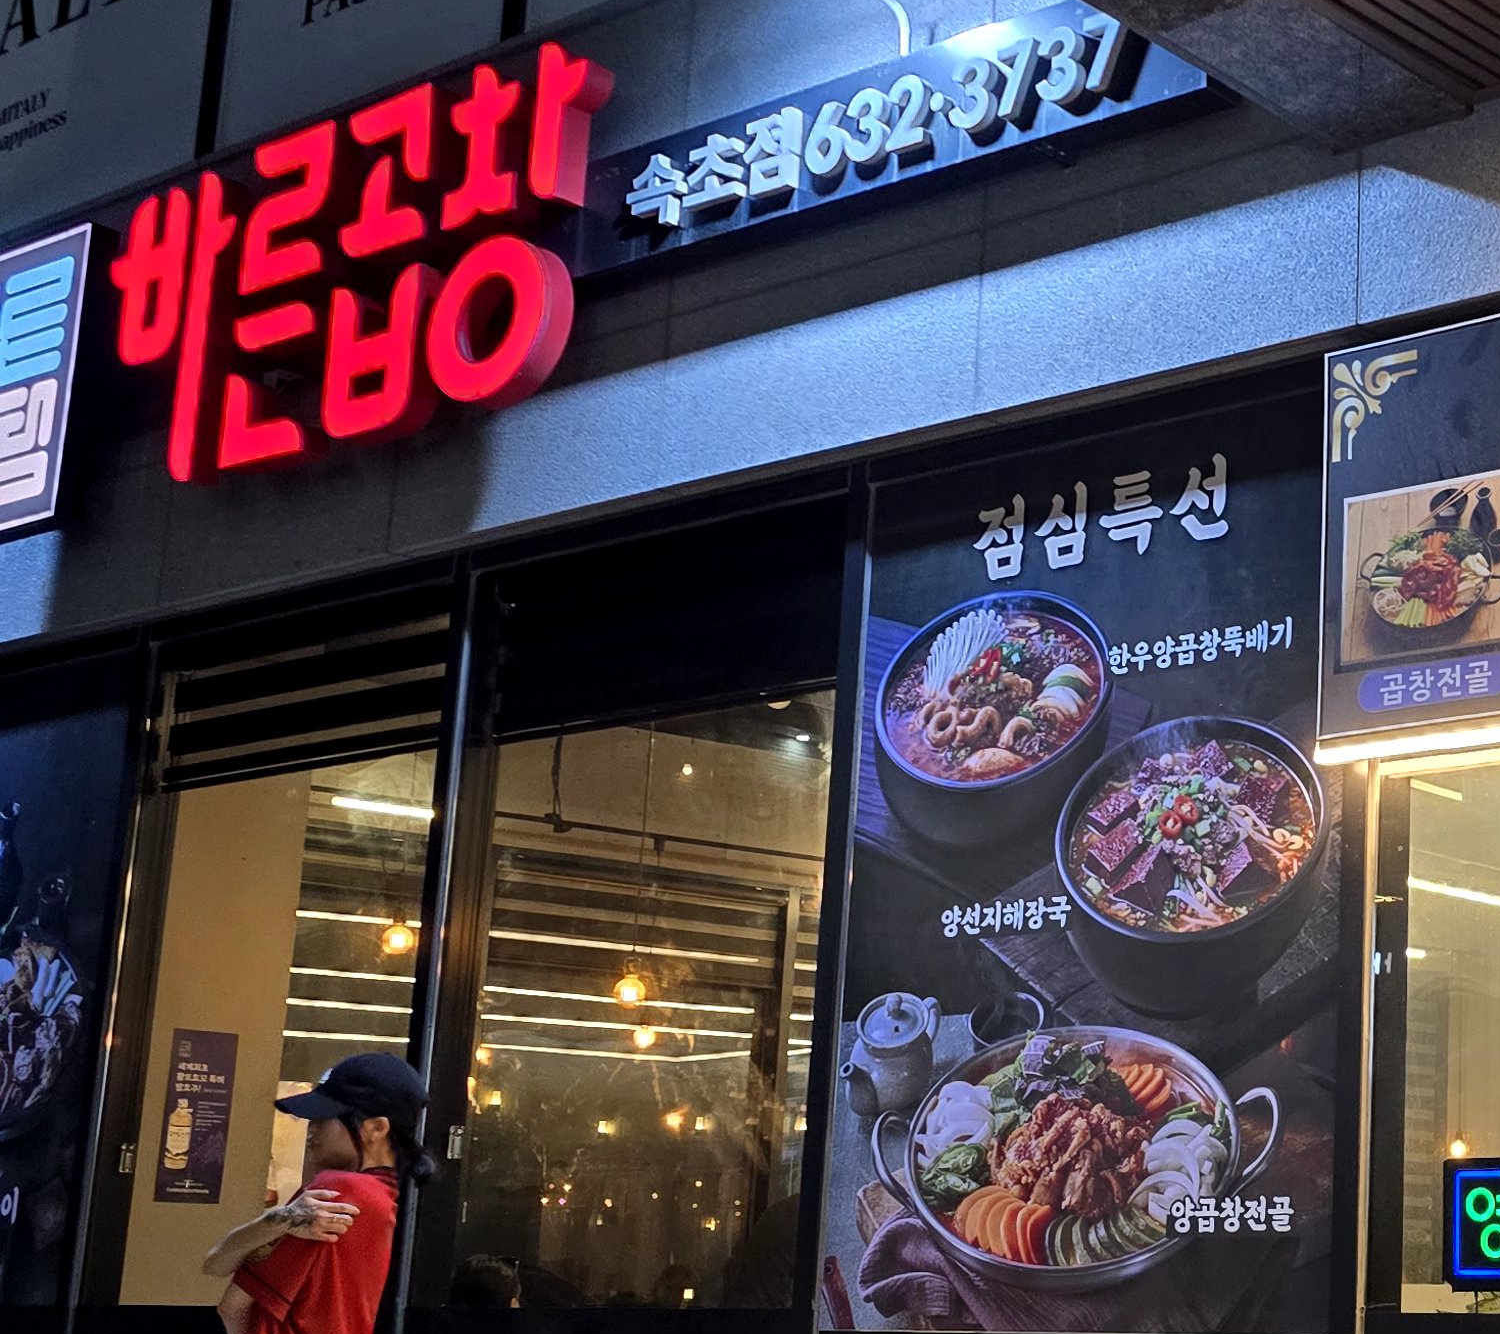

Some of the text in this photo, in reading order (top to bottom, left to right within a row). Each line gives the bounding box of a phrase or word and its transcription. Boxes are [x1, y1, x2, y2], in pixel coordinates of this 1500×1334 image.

[110, 41, 592, 482] 바른곱창
[972, 452, 1230, 581] 점심특선
[1108, 616, 1294, 676] 한우양곱창뚝배기
[1379, 658, 1494, 708] 곱창전골
[941, 896, 1072, 937] 양선지해장국
[1169, 1195, 1295, 1234] 양곱창전골
